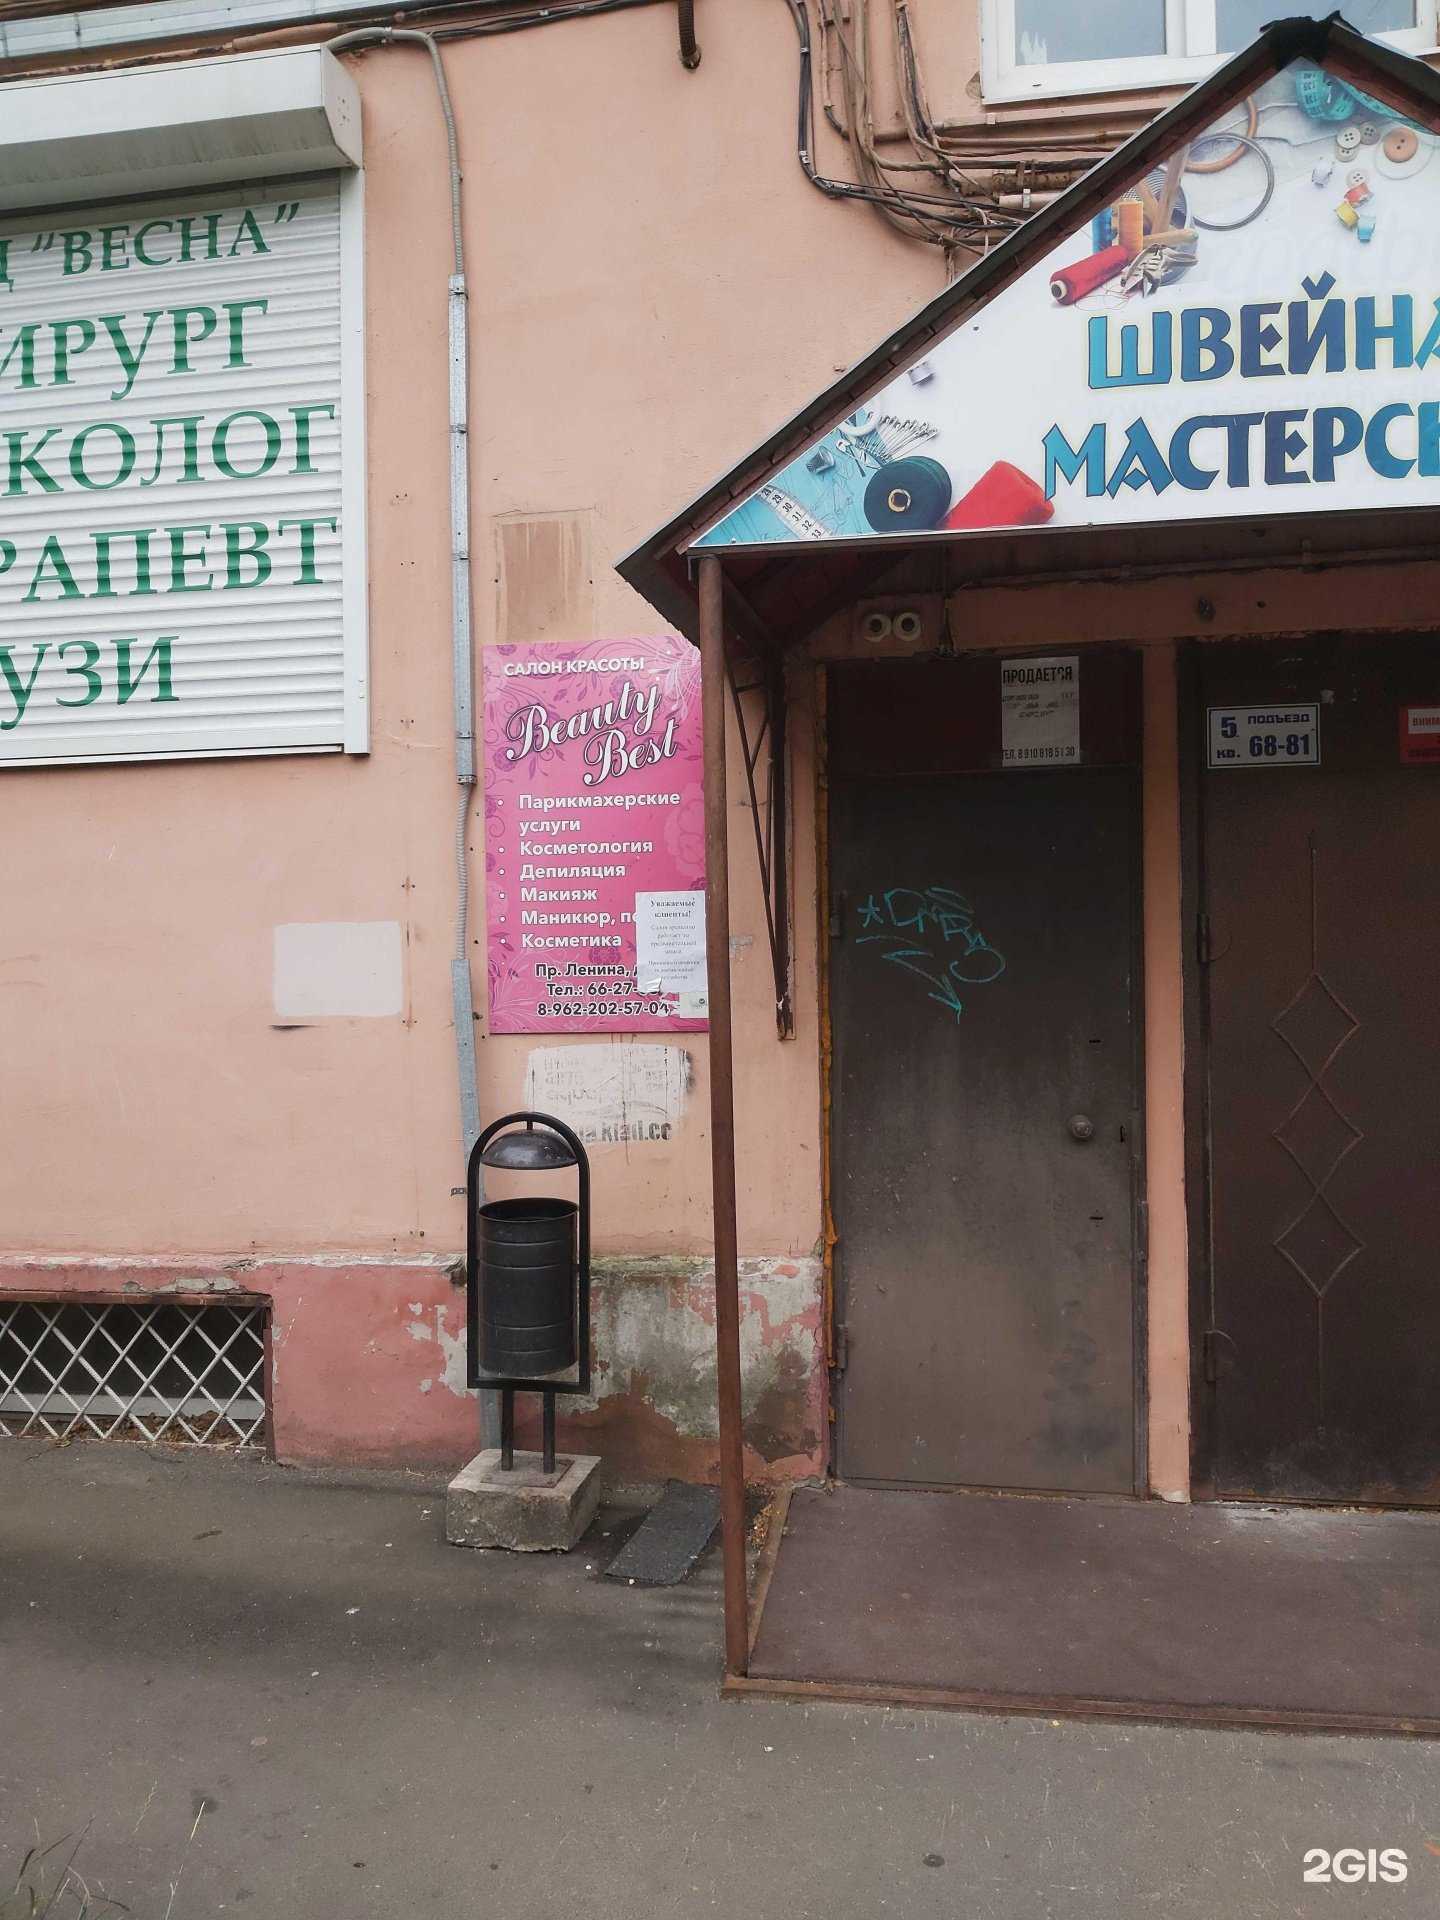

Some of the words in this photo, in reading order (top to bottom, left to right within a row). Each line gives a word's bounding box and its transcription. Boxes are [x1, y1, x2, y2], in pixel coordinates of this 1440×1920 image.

[2, 404, 335, 496] КОЛОГ
[504, 663, 563, 677] САЛОН
[567, 657, 645, 673] КРАСОТЫ
[1003, 666, 1073, 685] ПРОДАЕТСЯ
[0, 635, 180, 730] УЗИ
[506, 681, 662, 761] Beauty
[1220, 716, 1237, 739] 5
[583, 719, 680, 786] Best
[1249, 734, 1310, 757] 68-81
[518, 792, 681, 812] Парикмахерские
[519, 818, 582, 836] услуги
[520, 840, 653, 856] Косметология
[520, 864, 626, 881] Депиляция
[521, 887, 599, 902] Макияж
[521, 911, 616, 928] Маникюр,
[521, 934, 622, 948] Косметика
[535, 964, 562, 978] Пр.
[565, 964, 631, 978] Ленина,
[547, 984, 584, 997] Тел.:
